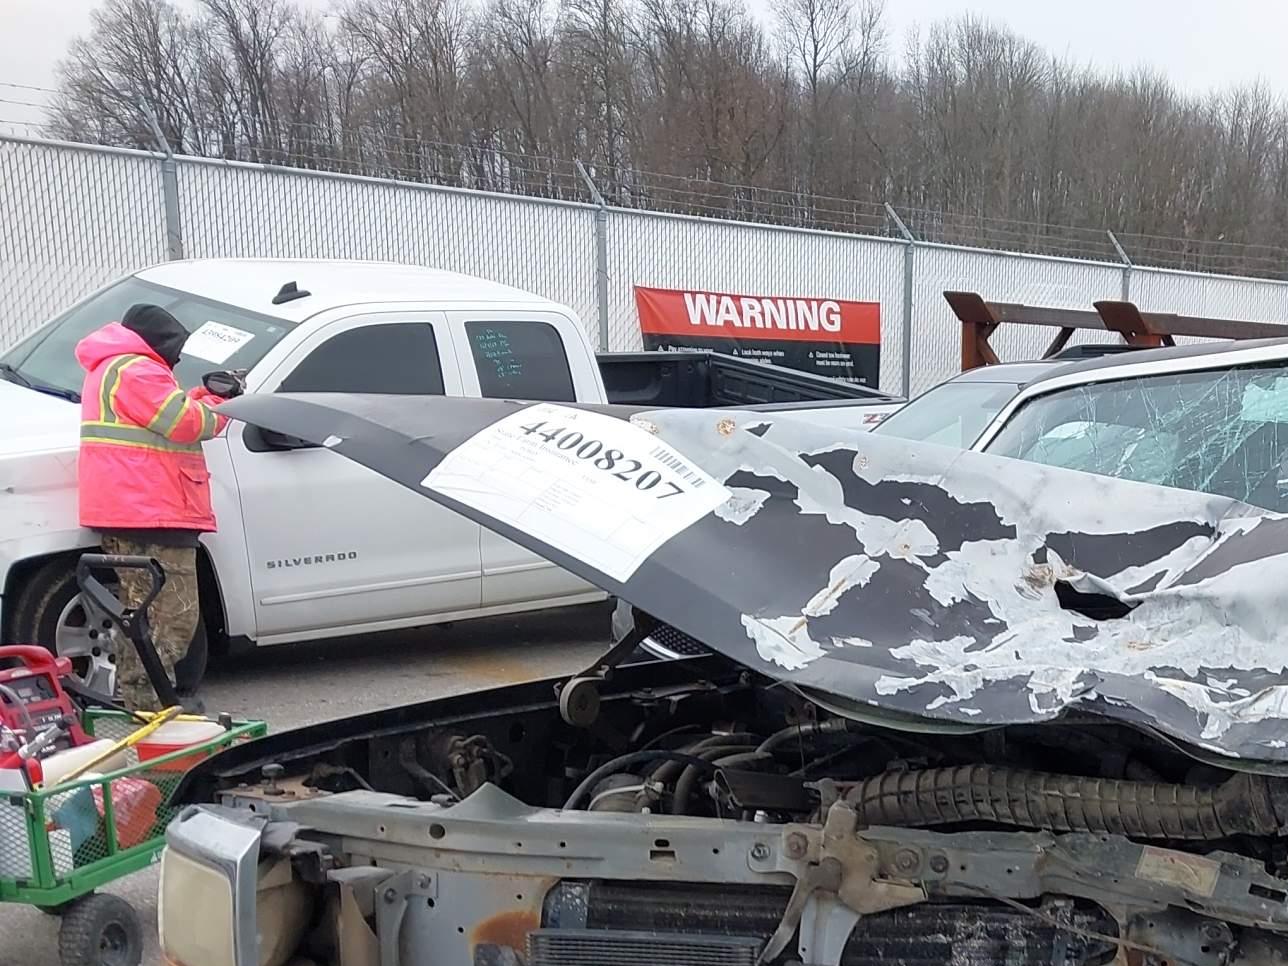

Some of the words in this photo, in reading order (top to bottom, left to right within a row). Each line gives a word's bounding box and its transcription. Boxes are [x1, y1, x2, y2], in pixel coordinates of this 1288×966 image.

[684, 293, 841, 332] WARNING
[863, 413, 890, 424] Z7
[520, 421, 684, 499] 44008207
[266, 551, 358, 569] SILVERADO
